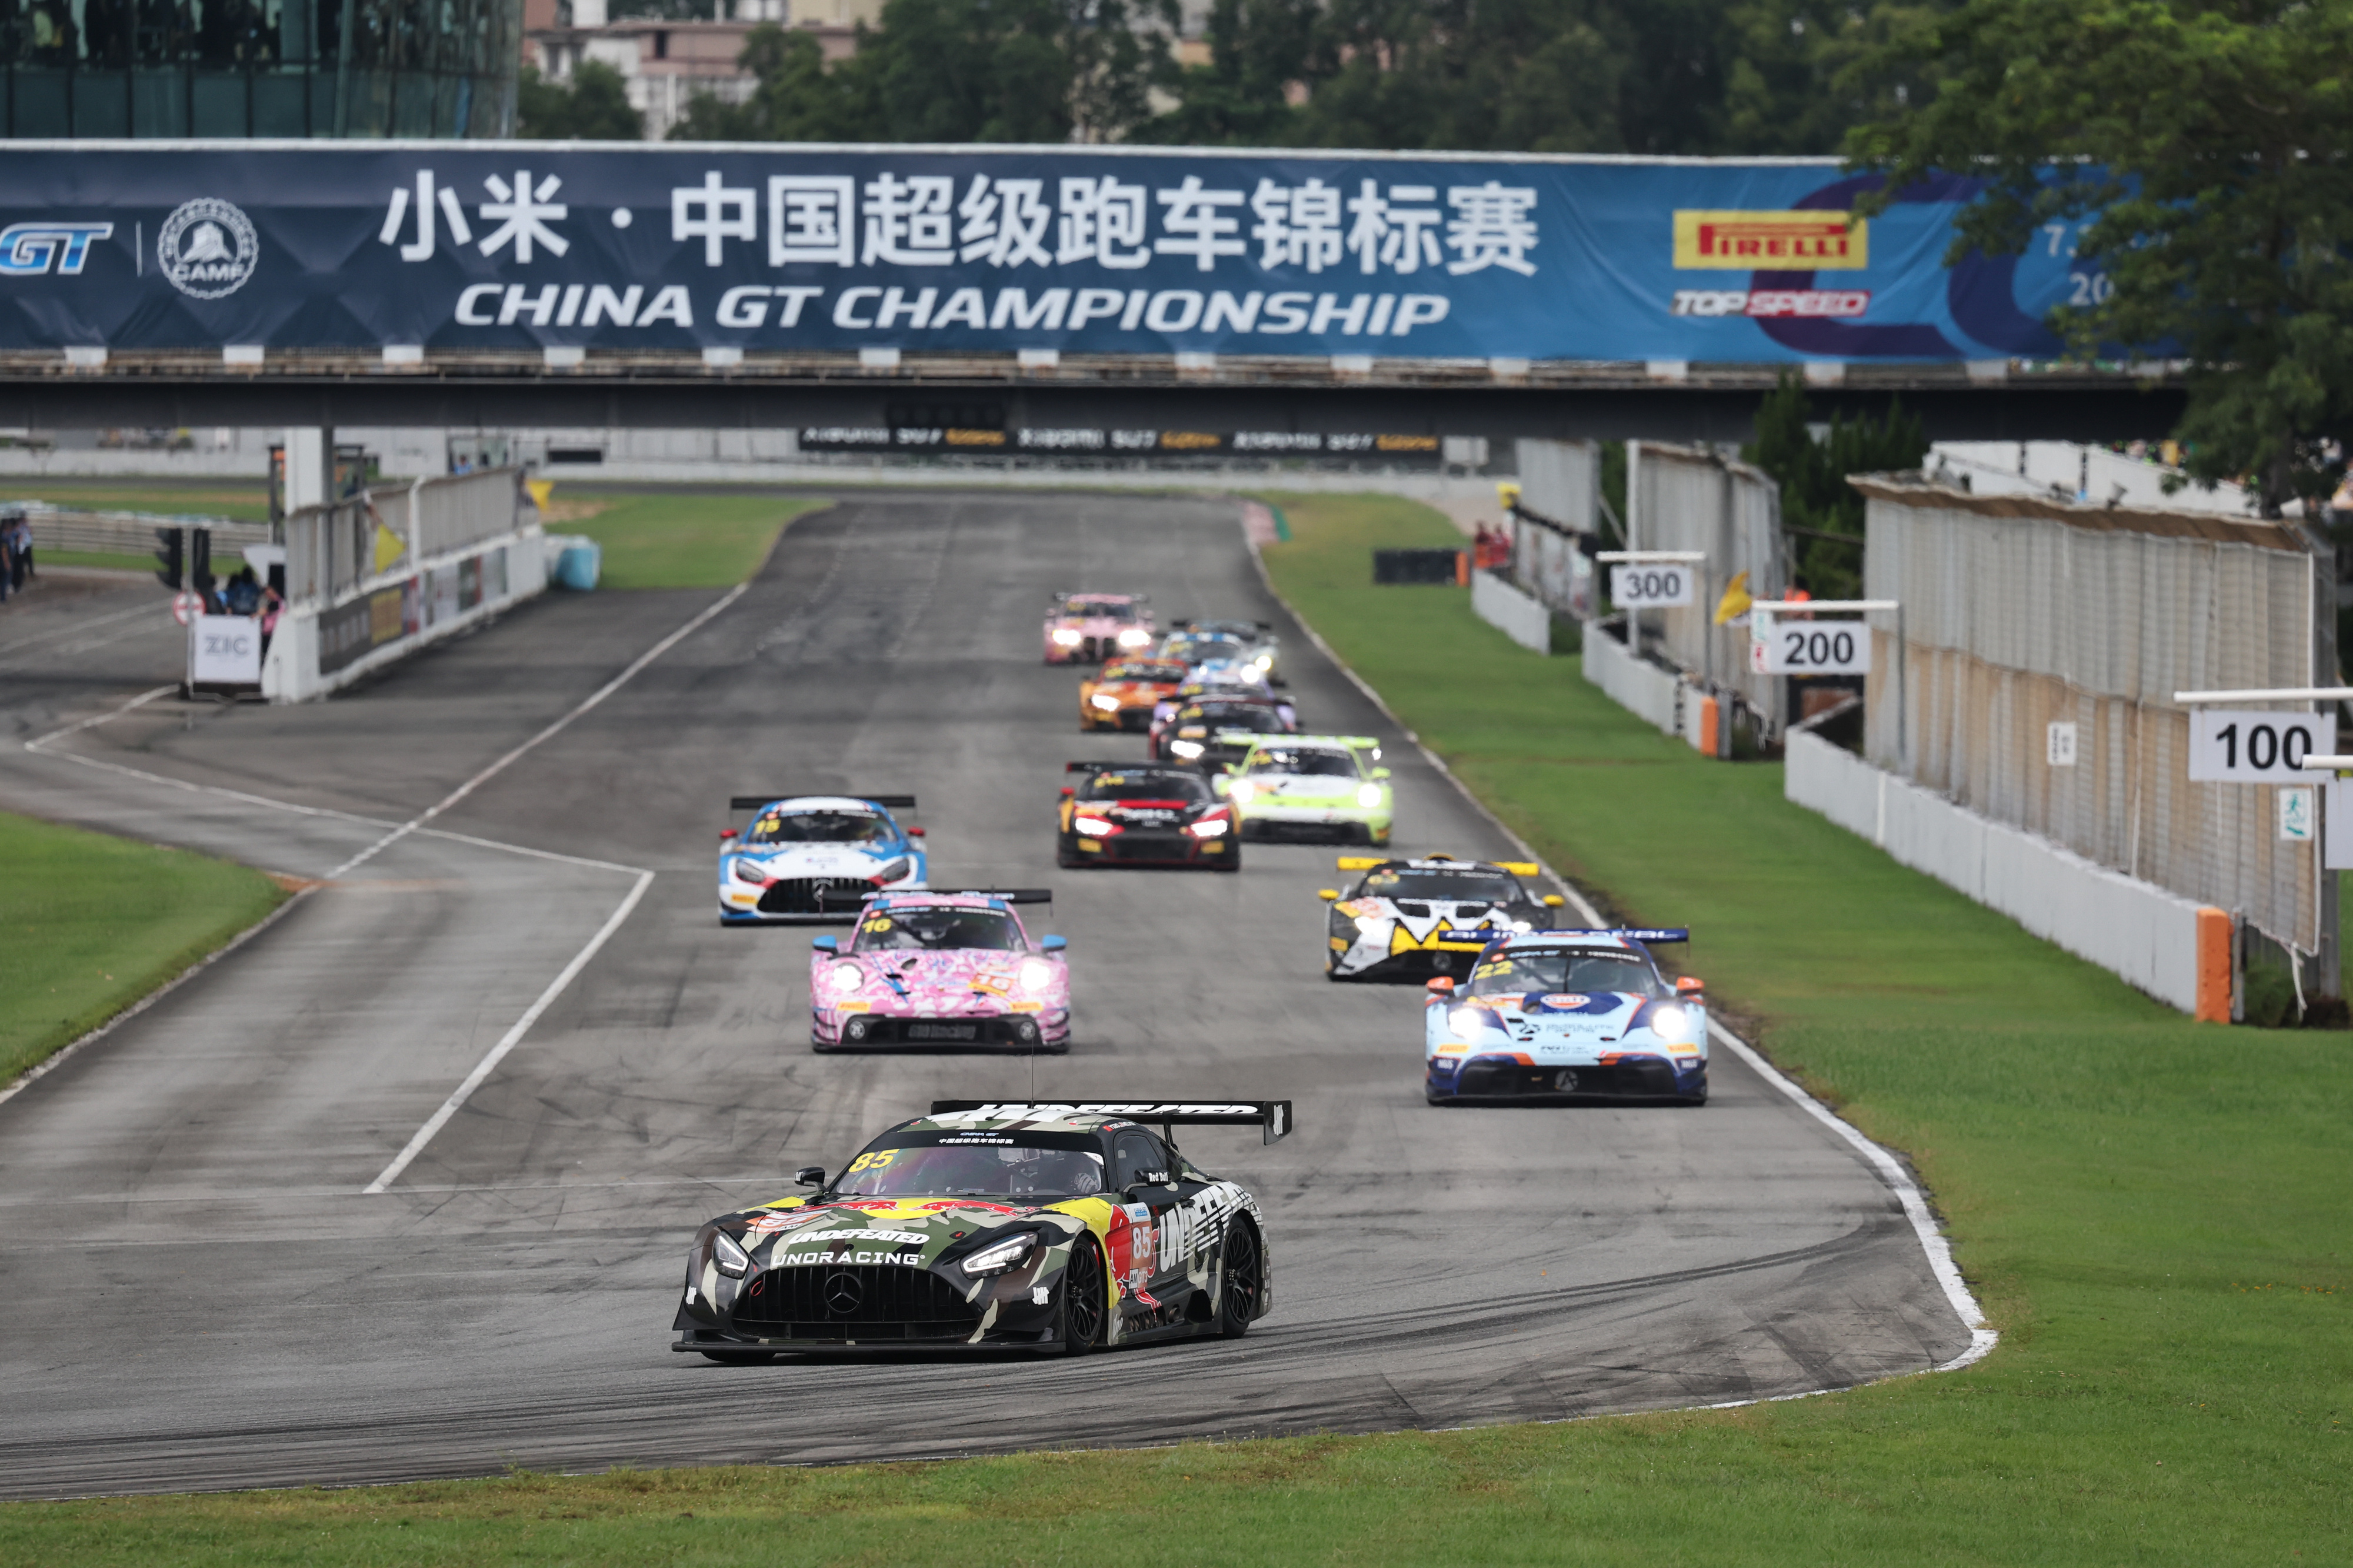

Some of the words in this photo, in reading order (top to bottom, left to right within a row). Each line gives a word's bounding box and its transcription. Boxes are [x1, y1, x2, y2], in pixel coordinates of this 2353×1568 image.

[0, 222, 114, 275] GT
[1699, 222, 1848, 255] PIRELLI
[455, 283, 693, 326] CHINA
[715, 285, 823, 328] GT
[832, 286, 1449, 336] CHAMPIONSHIP
[1626, 572, 1681, 599] 300
[205, 634, 249, 656] ZIC
[1785, 631, 1854, 665] 200
[2216, 723, 2312, 770] 100
[862, 918, 891, 933] 16
[1474, 960, 1513, 980] 22
[977, 974, 1011, 991] 16
[848, 1149, 900, 1173] 85
[1148, 1172, 1159, 1182] Red
[788, 1229, 930, 1245] UNDEFEATED
[1132, 1226, 1151, 1259] 85
[1130, 1273, 1138, 1285] AM
[1138, 1270, 1148, 1284] GT3
